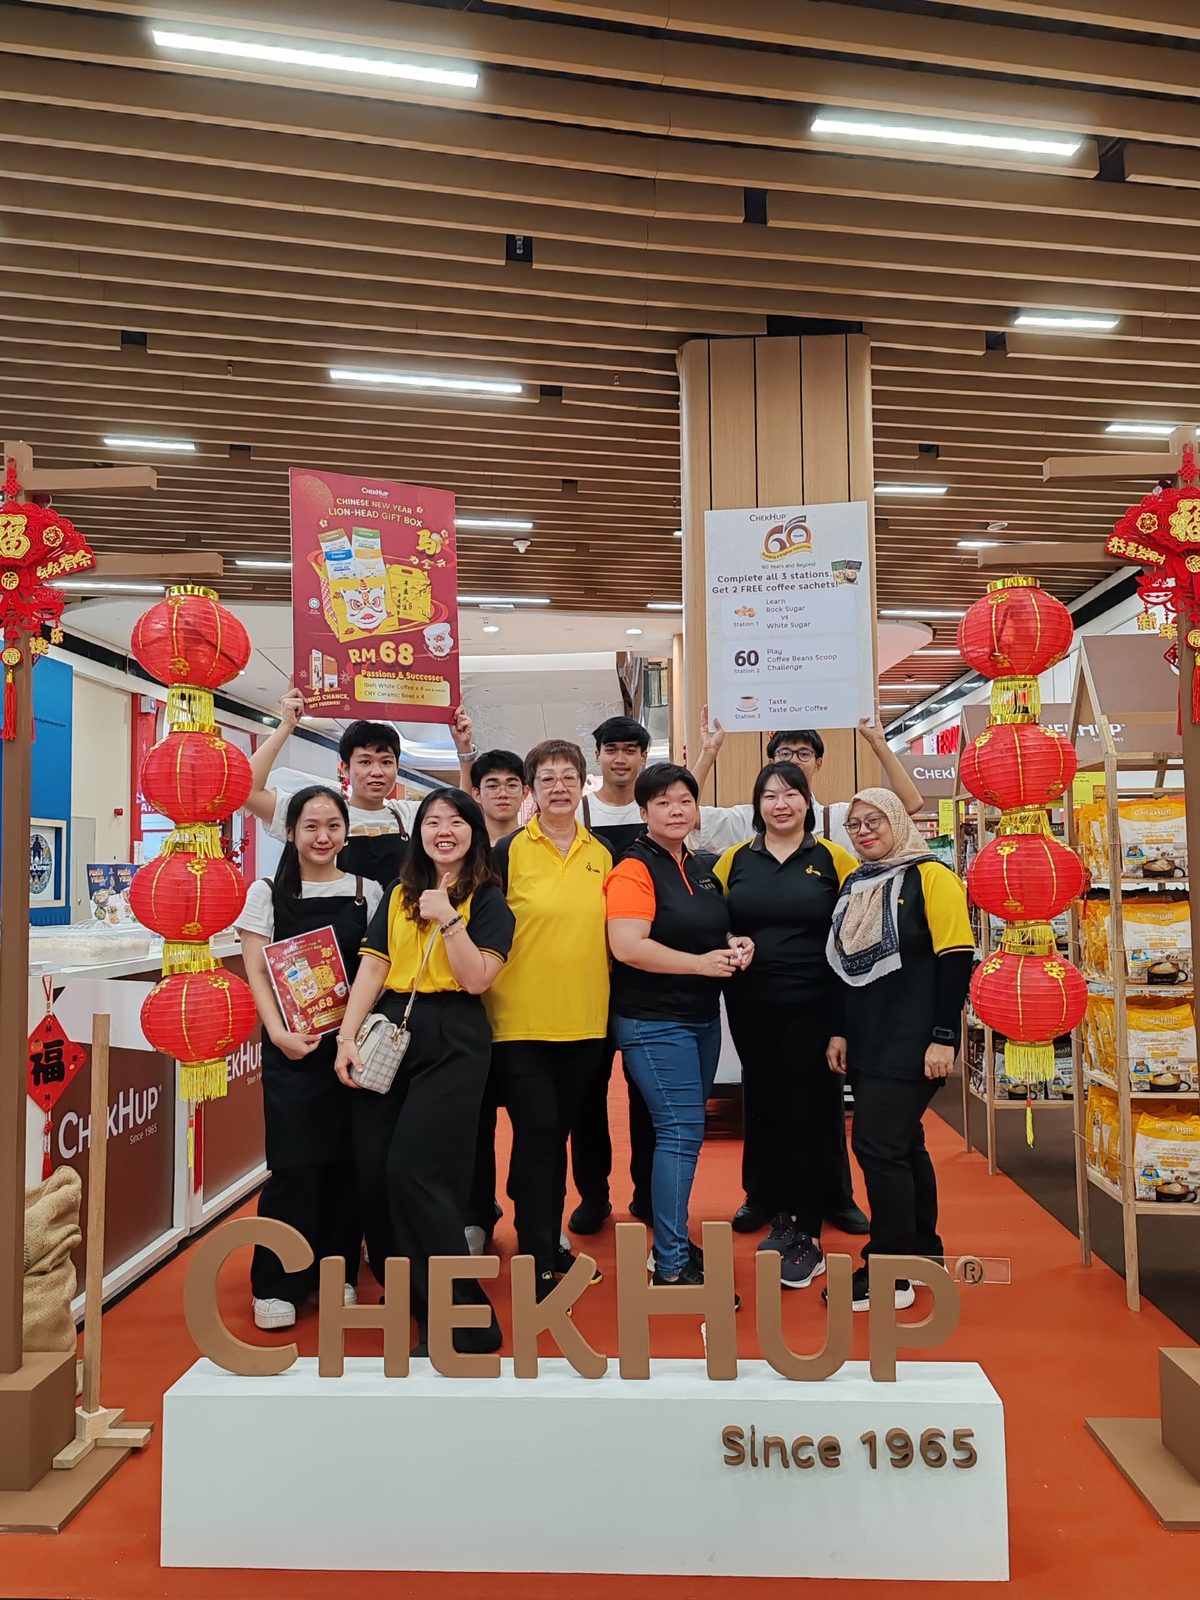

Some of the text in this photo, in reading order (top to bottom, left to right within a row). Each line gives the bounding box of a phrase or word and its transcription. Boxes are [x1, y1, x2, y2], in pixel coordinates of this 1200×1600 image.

[336, 497, 413, 515] CHINESE NEW YEAR
[328, 507, 423, 528] LION-HEAD GIFT BOX
[796, 561, 816, 569] Beyond
[717, 574, 763, 584] Complete
[765, 573, 778, 581] all
[781, 572, 787, 580] 3
[712, 580, 839, 594] Get 2 FREE coffee sachets!
[785, 605, 806, 614] Sugar
[790, 621, 811, 630] Sugar
[734, 649, 760, 667] 60
[791, 654, 813, 662] Beans
[815, 654, 837, 662] Scoop
[767, 663, 803, 672] Challenge
[361, 669, 396, 679] Passions
[406, 672, 444, 682] Successes
[363, 682, 378, 690] Ipoh
[378, 682, 396, 690] White
[397, 683, 415, 691] Coffee
[364, 689, 378, 697] CNY
[379, 690, 400, 699] Ceramic
[401, 691, 415, 699] Bowl
[30, 1039, 65, 1086] 福
[58, 1086, 159, 1159] CHKHUP
[129, 1122, 158, 1145] Since 1965
[184, 1216, 961, 1382] CHEKHUP
[721, 1424, 978, 1470] Since 1965
